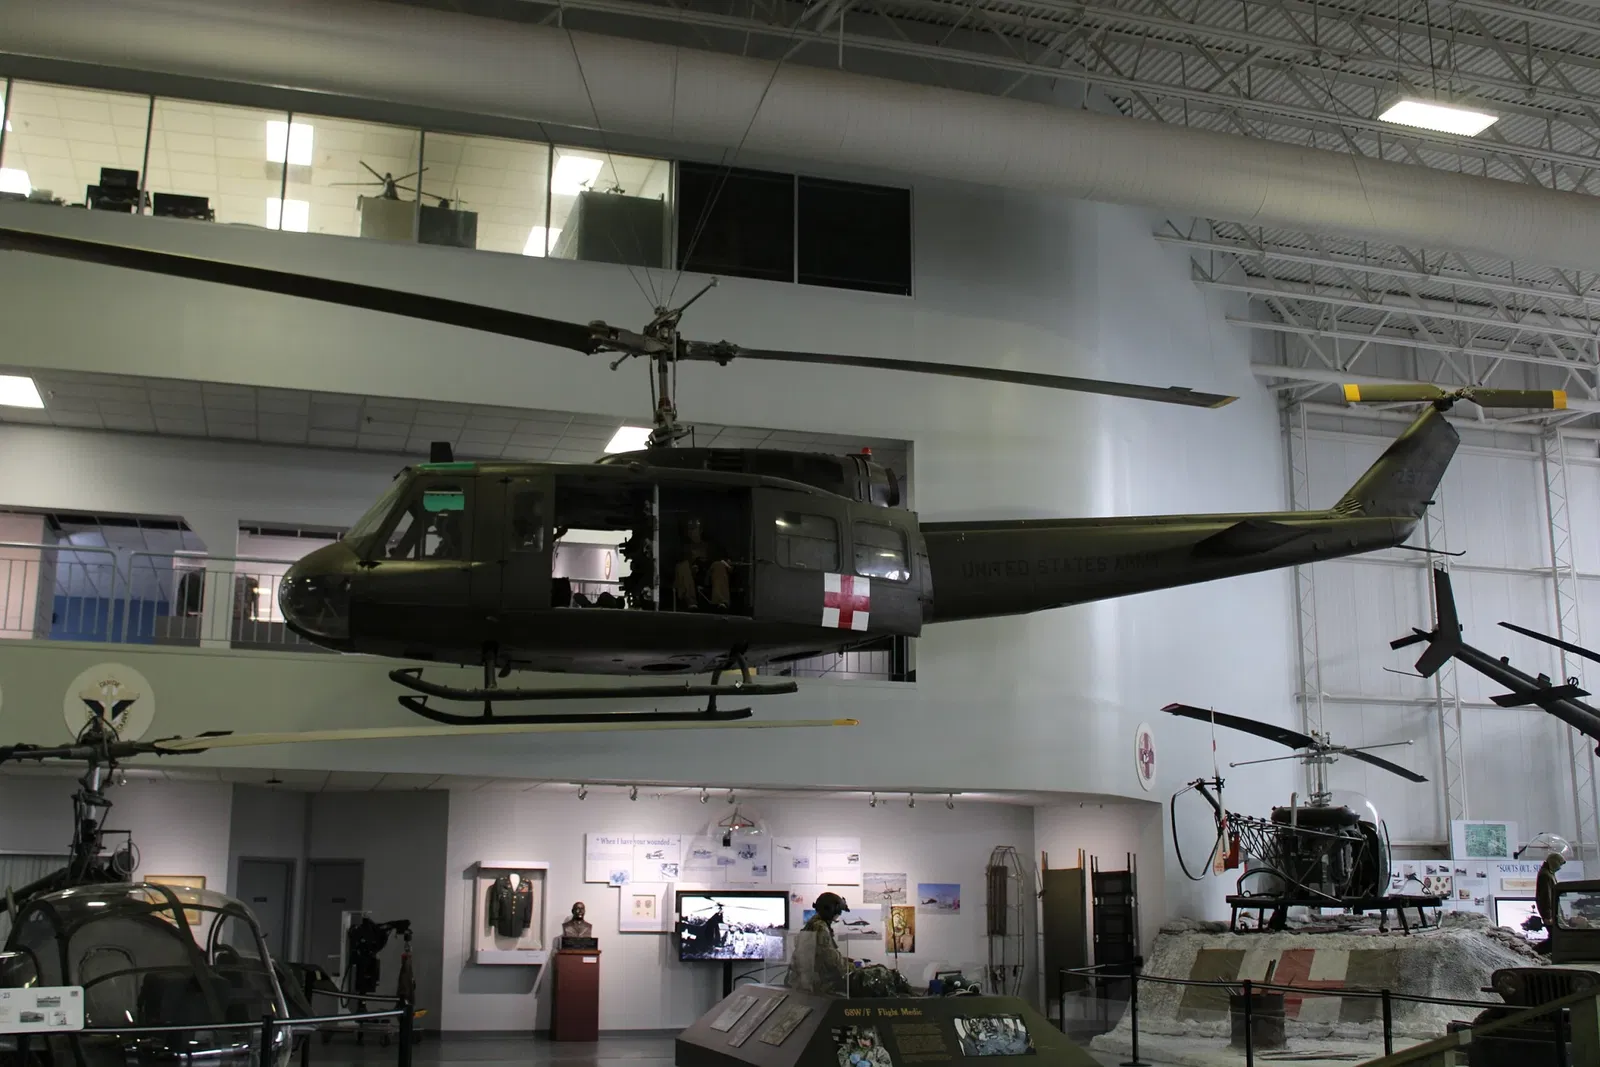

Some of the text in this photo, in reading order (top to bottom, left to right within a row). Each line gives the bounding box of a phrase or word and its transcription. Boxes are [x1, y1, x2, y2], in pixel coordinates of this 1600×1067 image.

[961, 559, 1029, 579] UNITED
[1037, 555, 1108, 574] STATES
[844, 1007, 924, 1018] 68W/F Flight Medic
